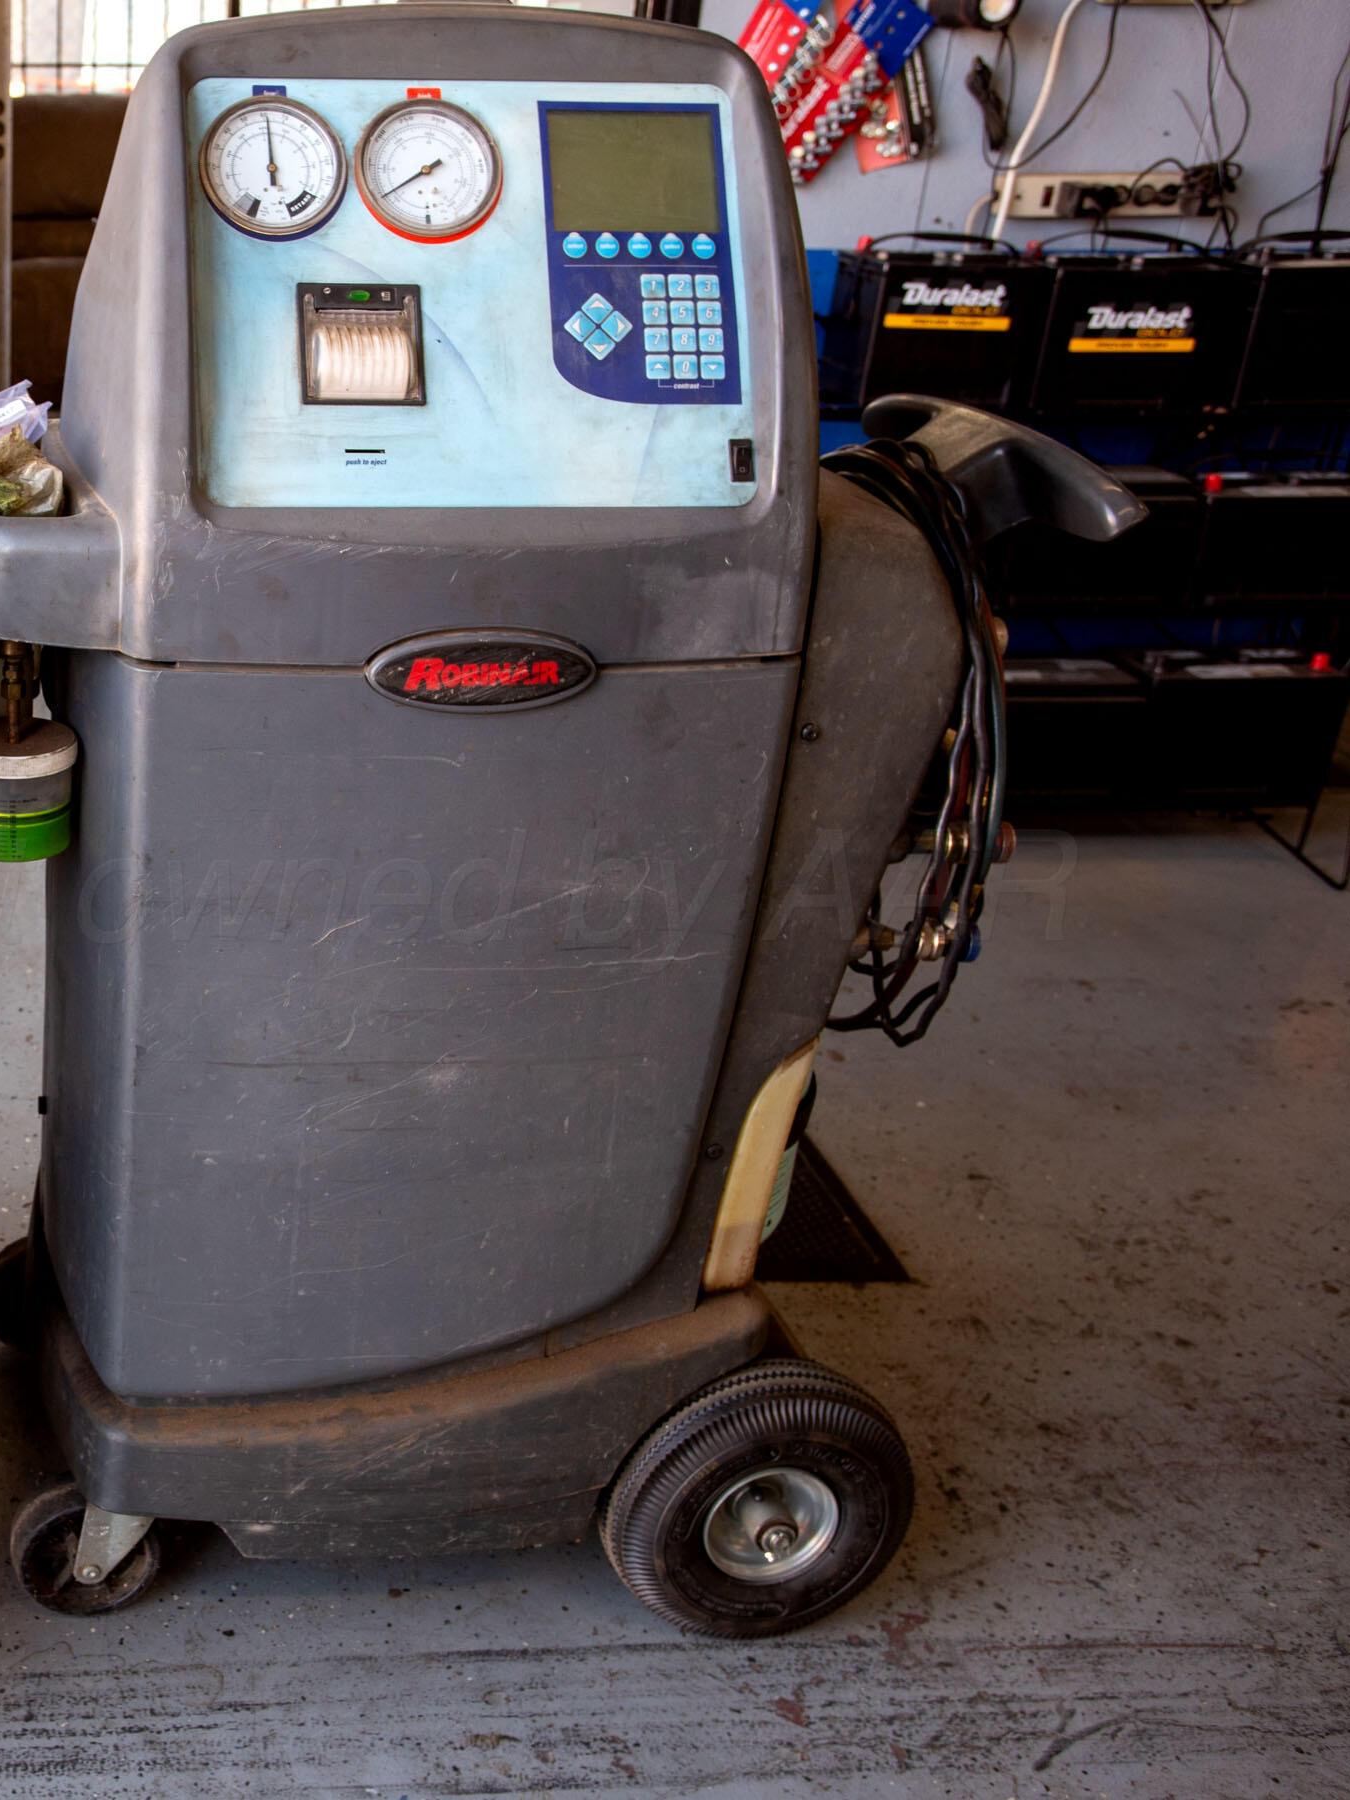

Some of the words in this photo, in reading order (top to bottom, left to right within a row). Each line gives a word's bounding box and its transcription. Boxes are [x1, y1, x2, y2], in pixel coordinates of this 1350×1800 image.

[650, 280, 657, 291] 1
[677, 280, 684, 292] 2
[704, 280, 712, 292] 3
[902, 281, 1007, 307] Duralast
[652, 307, 659, 318] 4
[678, 307, 686, 318] 5
[705, 307, 713, 318] 6
[1087, 306, 1192, 329] Duralast
[654, 334, 660, 345] 7
[680, 334, 688, 345] 8
[708, 334, 715, 345] 9
[682, 361, 690, 373] 0
[370, 458, 387, 467] eject
[403, 657, 560, 691] ROBINAIR
